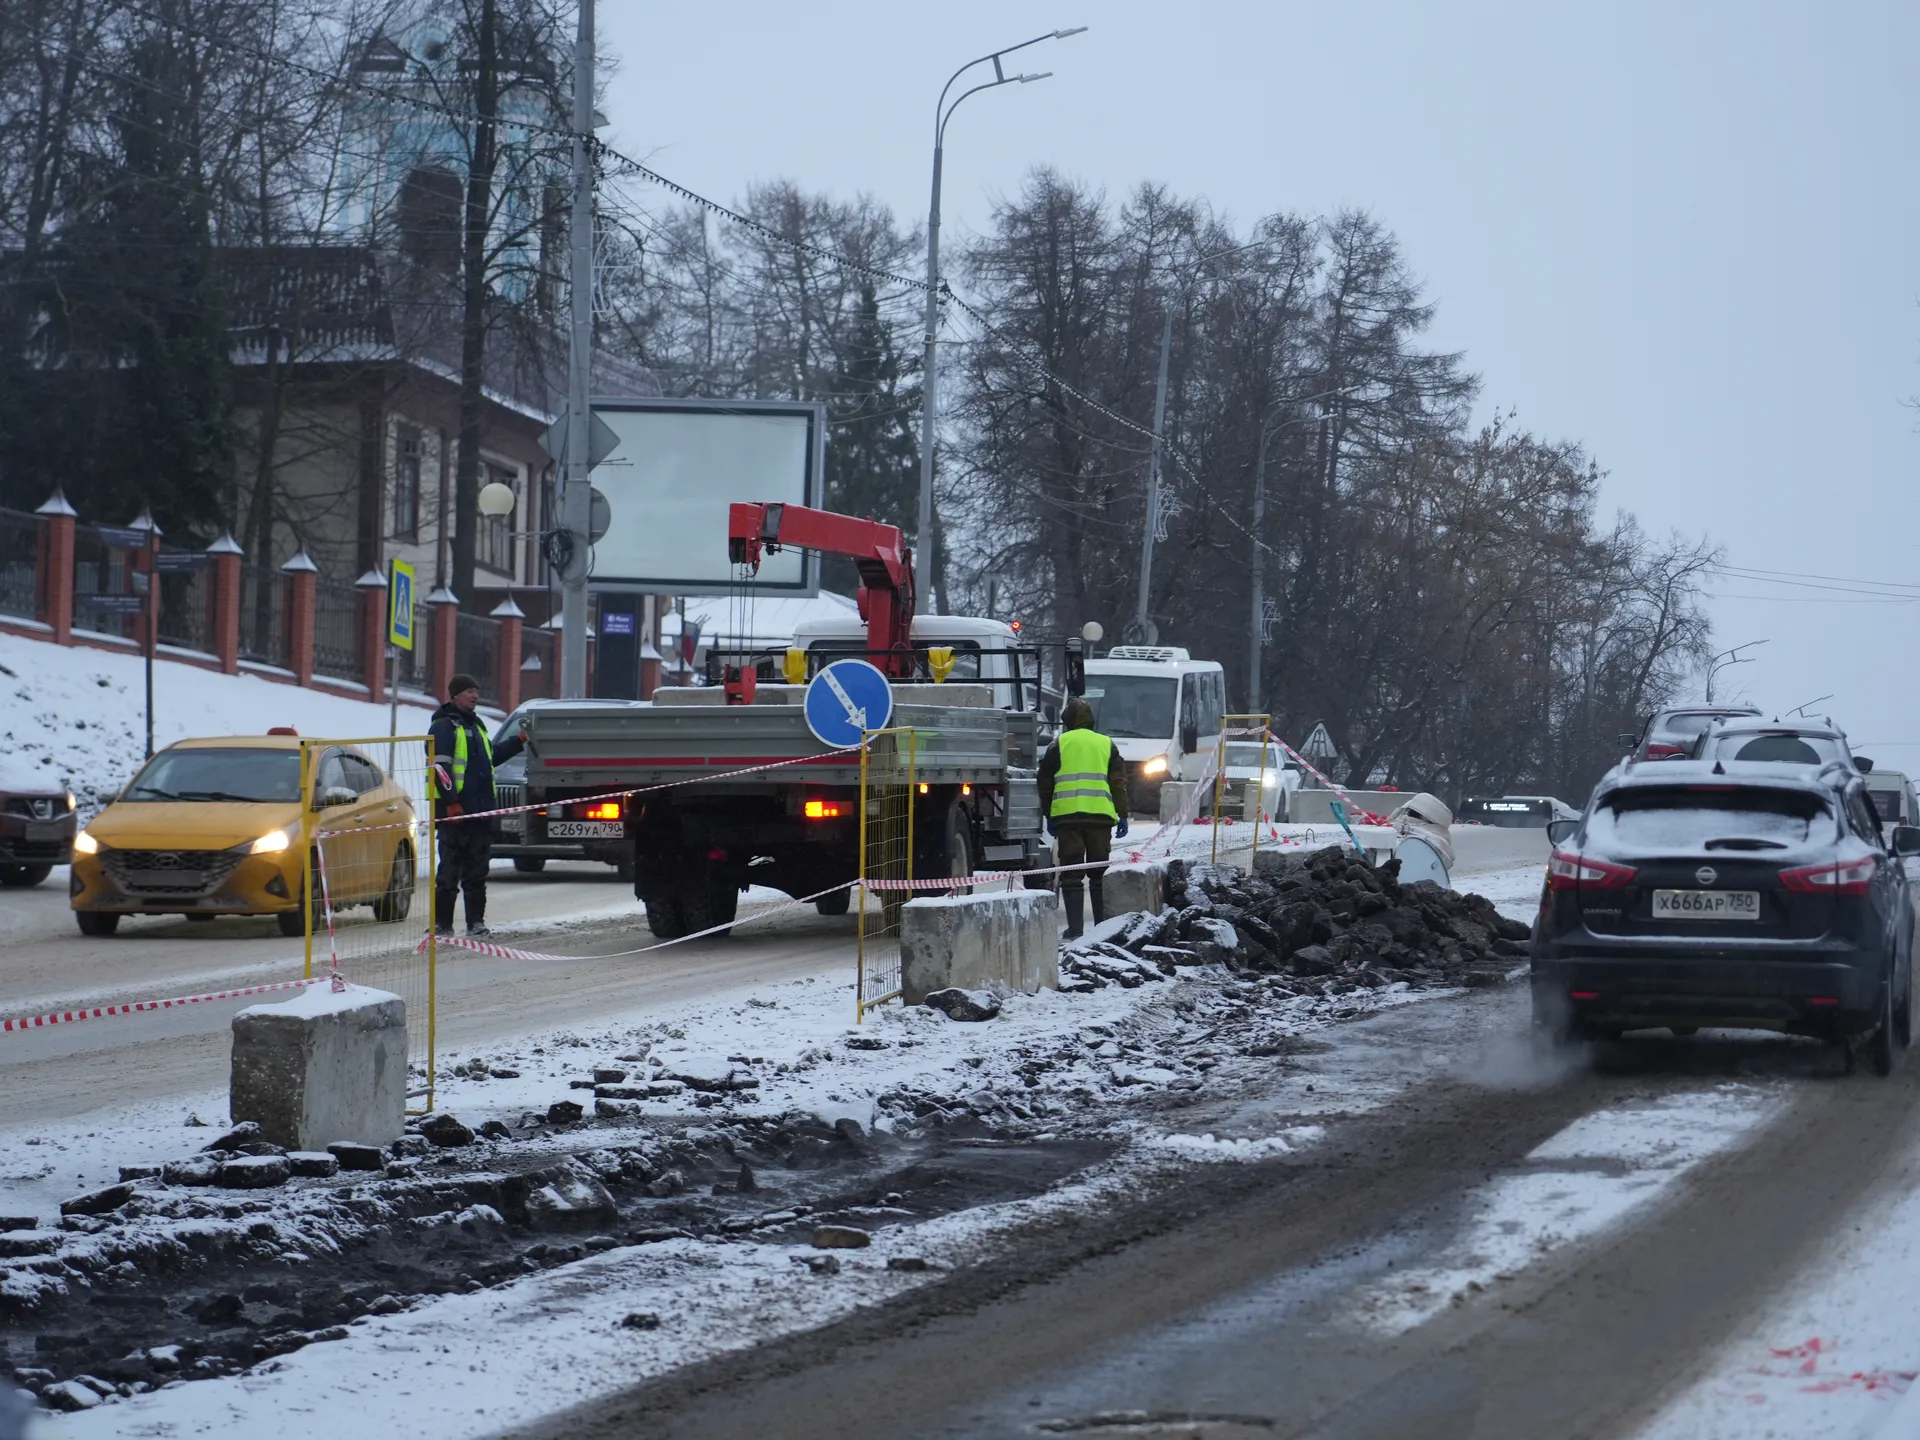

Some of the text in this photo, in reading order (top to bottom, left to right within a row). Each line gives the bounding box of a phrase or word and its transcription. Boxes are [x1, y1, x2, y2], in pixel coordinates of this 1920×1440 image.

[551, 822, 620, 836] С269УА 790
[1659, 893, 1754, 911] Х666АР 750
